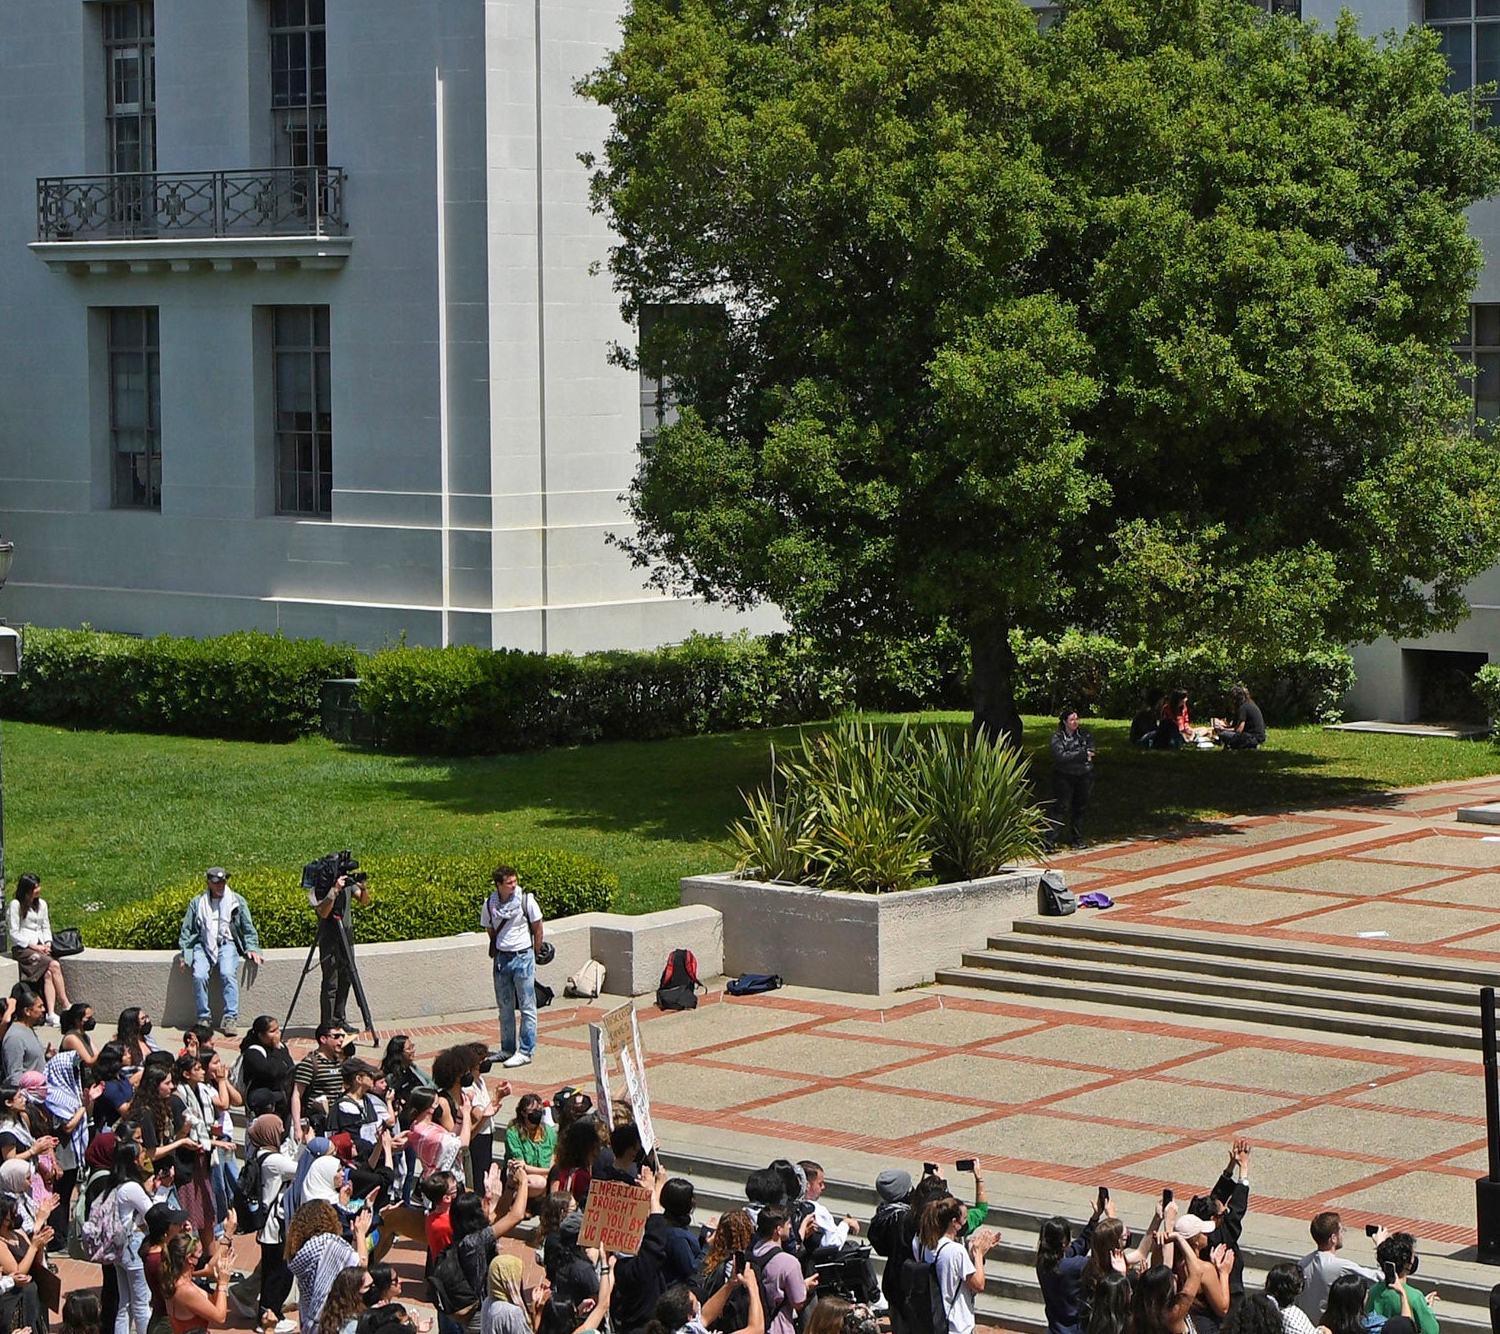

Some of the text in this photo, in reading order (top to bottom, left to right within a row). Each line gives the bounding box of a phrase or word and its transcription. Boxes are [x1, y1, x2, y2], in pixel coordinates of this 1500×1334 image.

[592, 1196, 638, 1216] BROUGHT
[587, 1209, 645, 1232] TO YOU BY
[584, 1227, 596, 1241] UC
